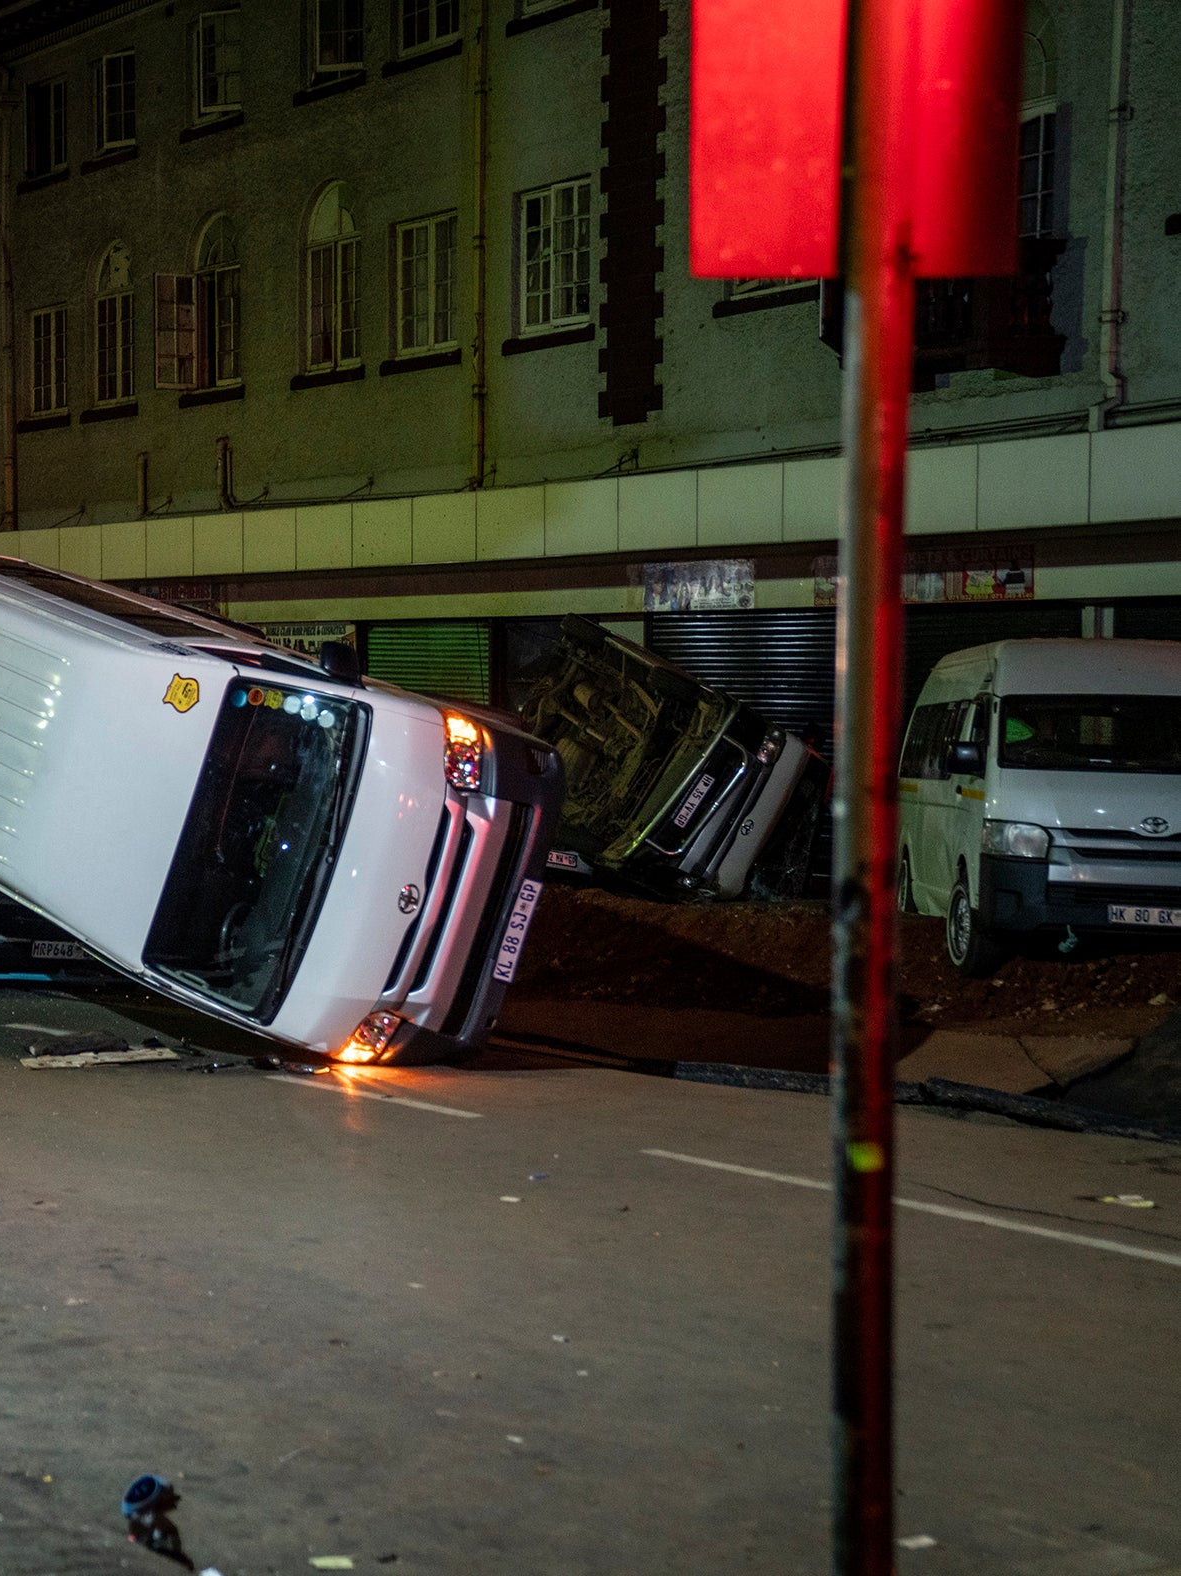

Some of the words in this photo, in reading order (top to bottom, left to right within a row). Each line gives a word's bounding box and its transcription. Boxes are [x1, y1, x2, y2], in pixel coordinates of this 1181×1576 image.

[701, 775, 713, 787] HP
[692, 788, 704, 800] 35
[676, 814, 688, 826] GP
[519, 883, 537, 902] GP
[510, 911, 527, 931] SJ
[1111, 907, 1126, 921] HK
[1134, 909, 1150, 922] 80
[502, 935, 520, 954] 88
[496, 960, 513, 979] KL
